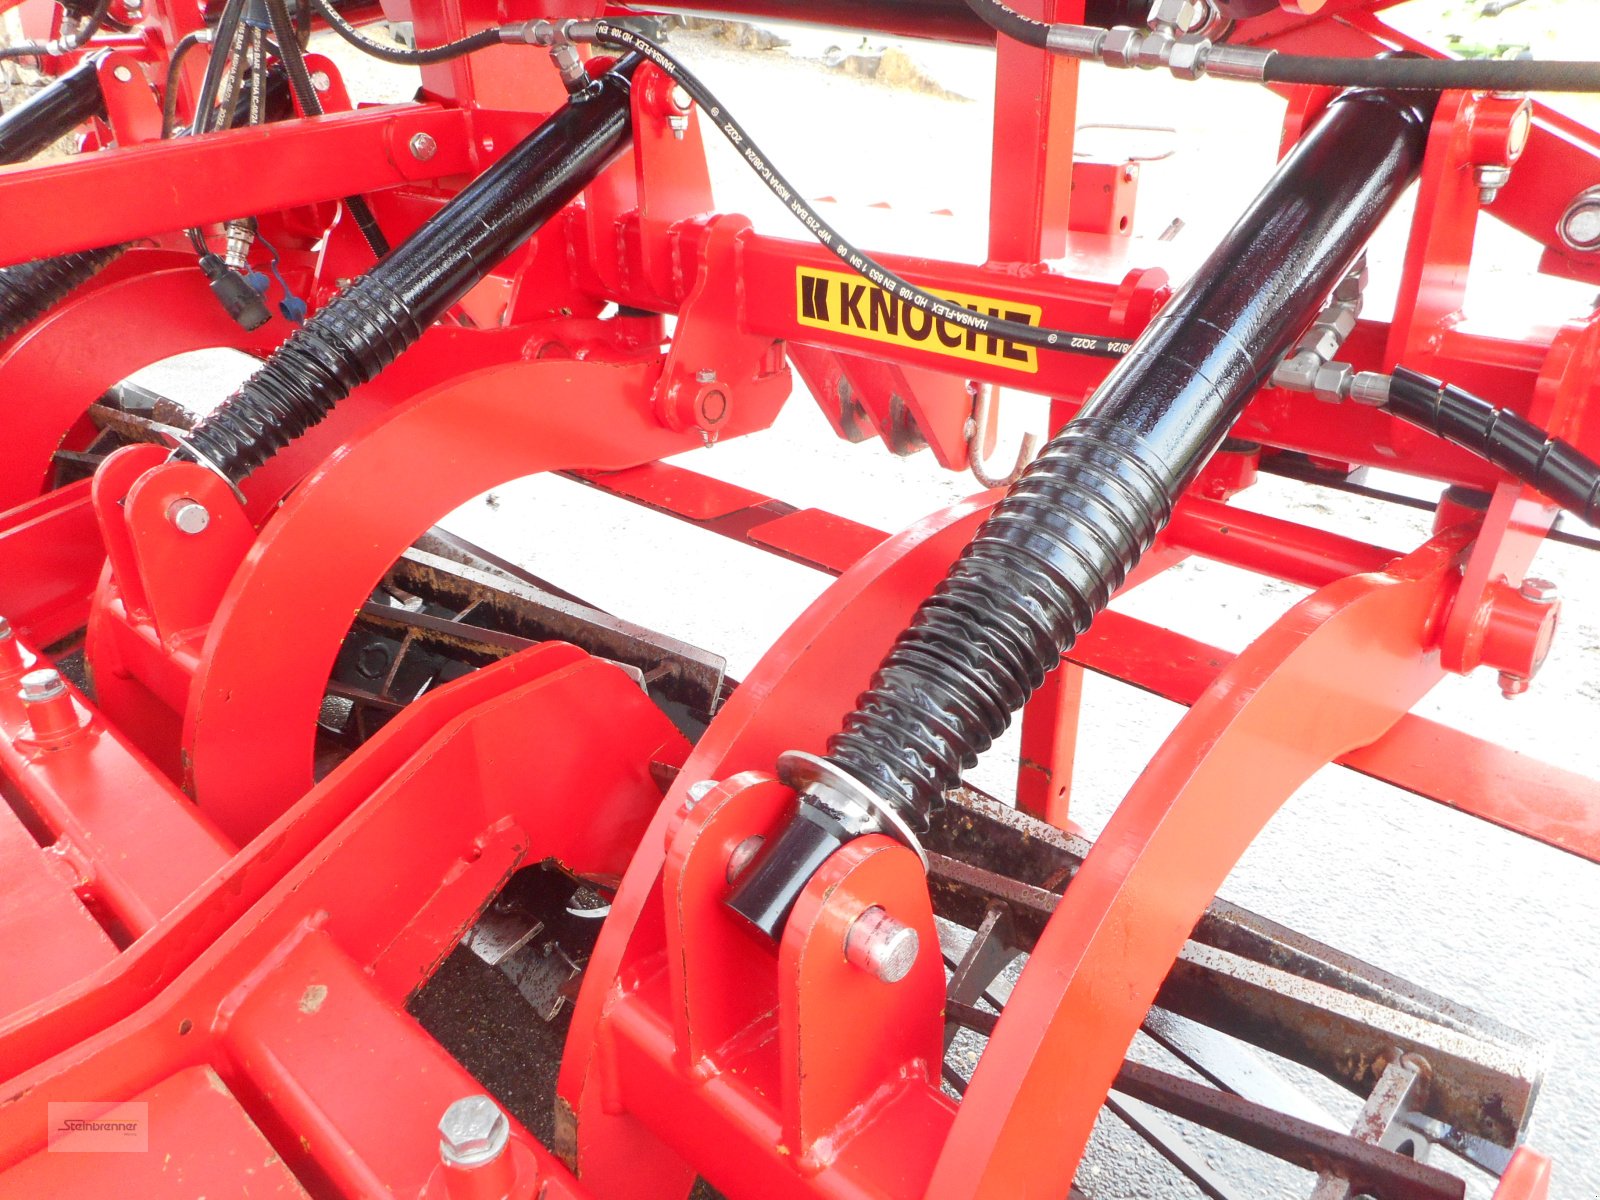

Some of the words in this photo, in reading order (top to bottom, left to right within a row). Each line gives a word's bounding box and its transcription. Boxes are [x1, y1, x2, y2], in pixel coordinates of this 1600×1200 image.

[598, 25, 609, 35] EN
[621, 32, 634, 44] HD
[634, 38, 676, 74] HANSA-FLEX
[724, 122, 743, 145] 2Q22
[769, 175, 791, 202] MSHA
[791, 199, 809, 221] BAR
[805, 216, 821, 232] 215
[817, 229, 832, 244] WP
[836, 244, 848, 257] 08
[849, 254, 863, 268] SN
[868, 268, 884, 283] 853
[882, 277, 897, 291] EN
[899, 287, 914, 300] 108
[914, 295, 929, 308] HD
[840, 282, 1032, 363] KNOCHE
[931, 302, 989, 331] HANSA-FLEX
[1070, 336, 1098, 350] 2Q22
